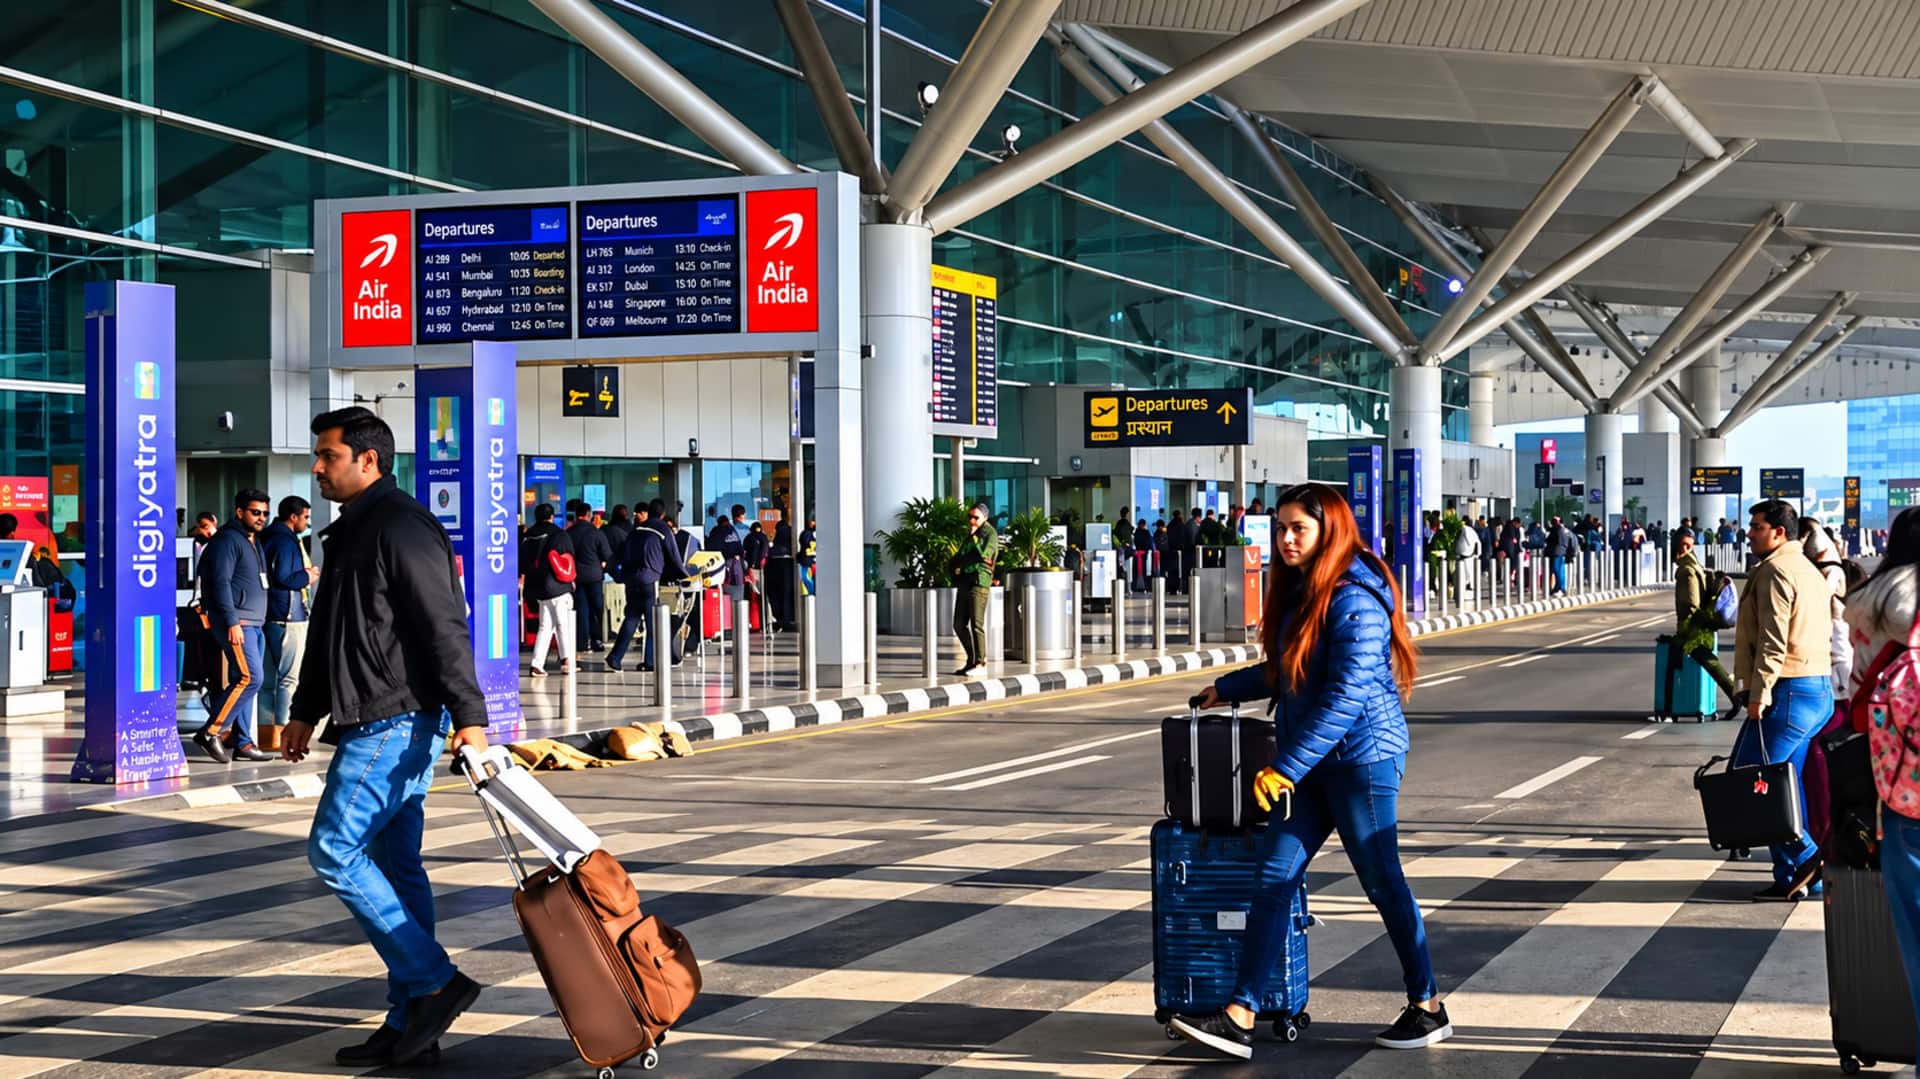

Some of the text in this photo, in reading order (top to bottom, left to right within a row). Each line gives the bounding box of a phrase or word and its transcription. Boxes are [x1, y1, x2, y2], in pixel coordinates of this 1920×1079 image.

[586, 215, 658, 232] Departures
[425, 222, 494, 240] Departures
[461, 252, 481, 263] Delhi
[533, 250, 565, 262] Departed
[586, 248, 597, 258] LH
[624, 245, 654, 256] Munich
[700, 242, 732, 252] Check-in
[598, 264, 612, 274] 312
[624, 264, 655, 274] London
[700, 261, 712, 270] On
[712, 260, 731, 270] Time
[762, 260, 794, 282] Air
[436, 271, 450, 281] 541
[461, 270, 494, 280] Mumbai
[358, 279, 389, 299] Air
[599, 281, 614, 292] 517
[624, 280, 649, 291] Dubai
[700, 278, 712, 288] On
[712, 278, 732, 288] Time
[461, 287, 502, 300] Bengaluru
[757, 282, 809, 304] India
[353, 299, 402, 320] India
[462, 304, 504, 317] Hyderabad
[534, 302, 546, 312] On
[547, 302, 565, 312] Time
[625, 298, 666, 310] Singapore
[700, 296, 712, 306] On
[713, 296, 732, 305] Time
[462, 321, 494, 332] Chennai
[534, 320, 546, 330] On
[547, 320, 565, 329] Time
[625, 316, 668, 327] Melbourne
[701, 314, 712, 324] On
[714, 313, 732, 323] Time
[1126, 396, 1209, 415] Departures
[132, 414, 164, 588] digiyatra
[486, 437, 508, 574] digiyatra
[121, 731, 128, 740] A
[122, 744, 128, 753] A
[122, 758, 128, 766] A
